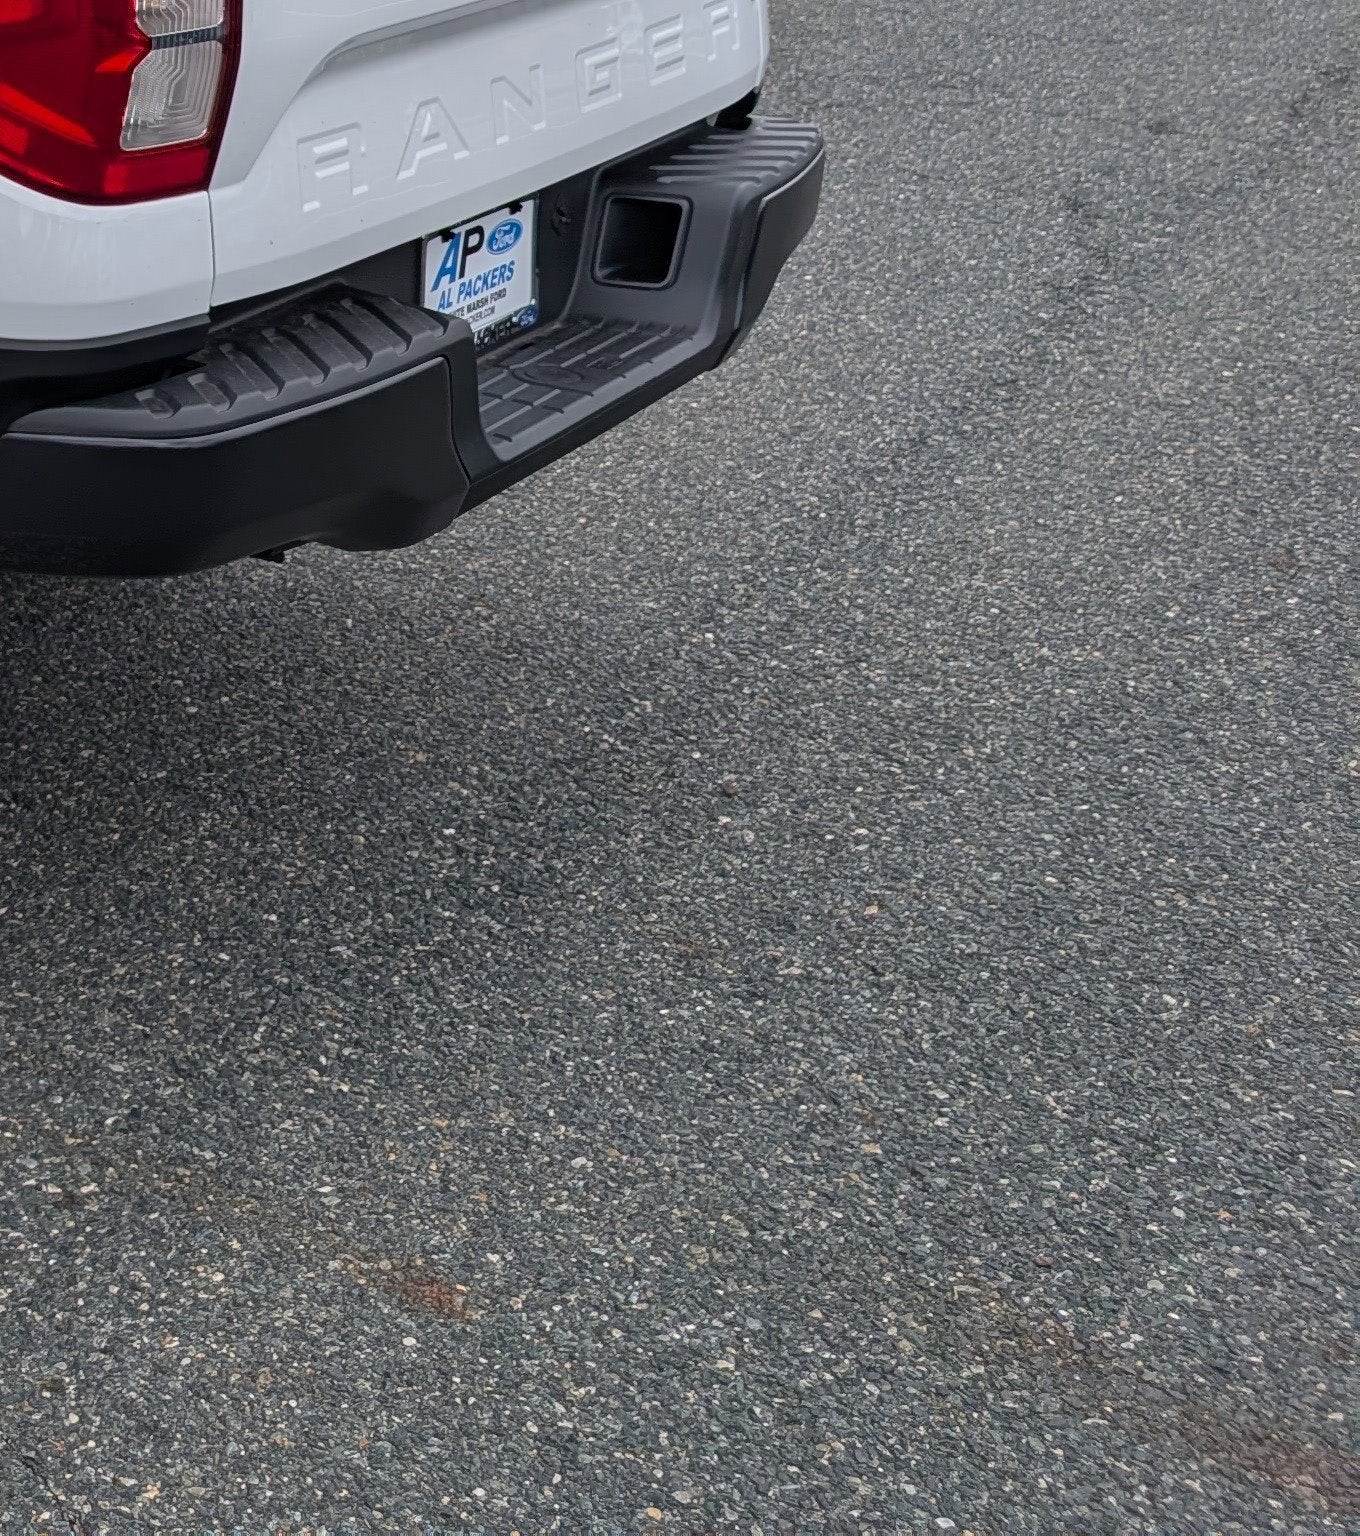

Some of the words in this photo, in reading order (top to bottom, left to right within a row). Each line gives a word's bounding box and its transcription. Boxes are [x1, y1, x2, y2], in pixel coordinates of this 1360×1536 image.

[430, 224, 485, 292] AP
[492, 224, 516, 251] Ford
[437, 288, 453, 311] AL
[456, 260, 515, 304] PACKERS
[490, 287, 507, 304] FORD
